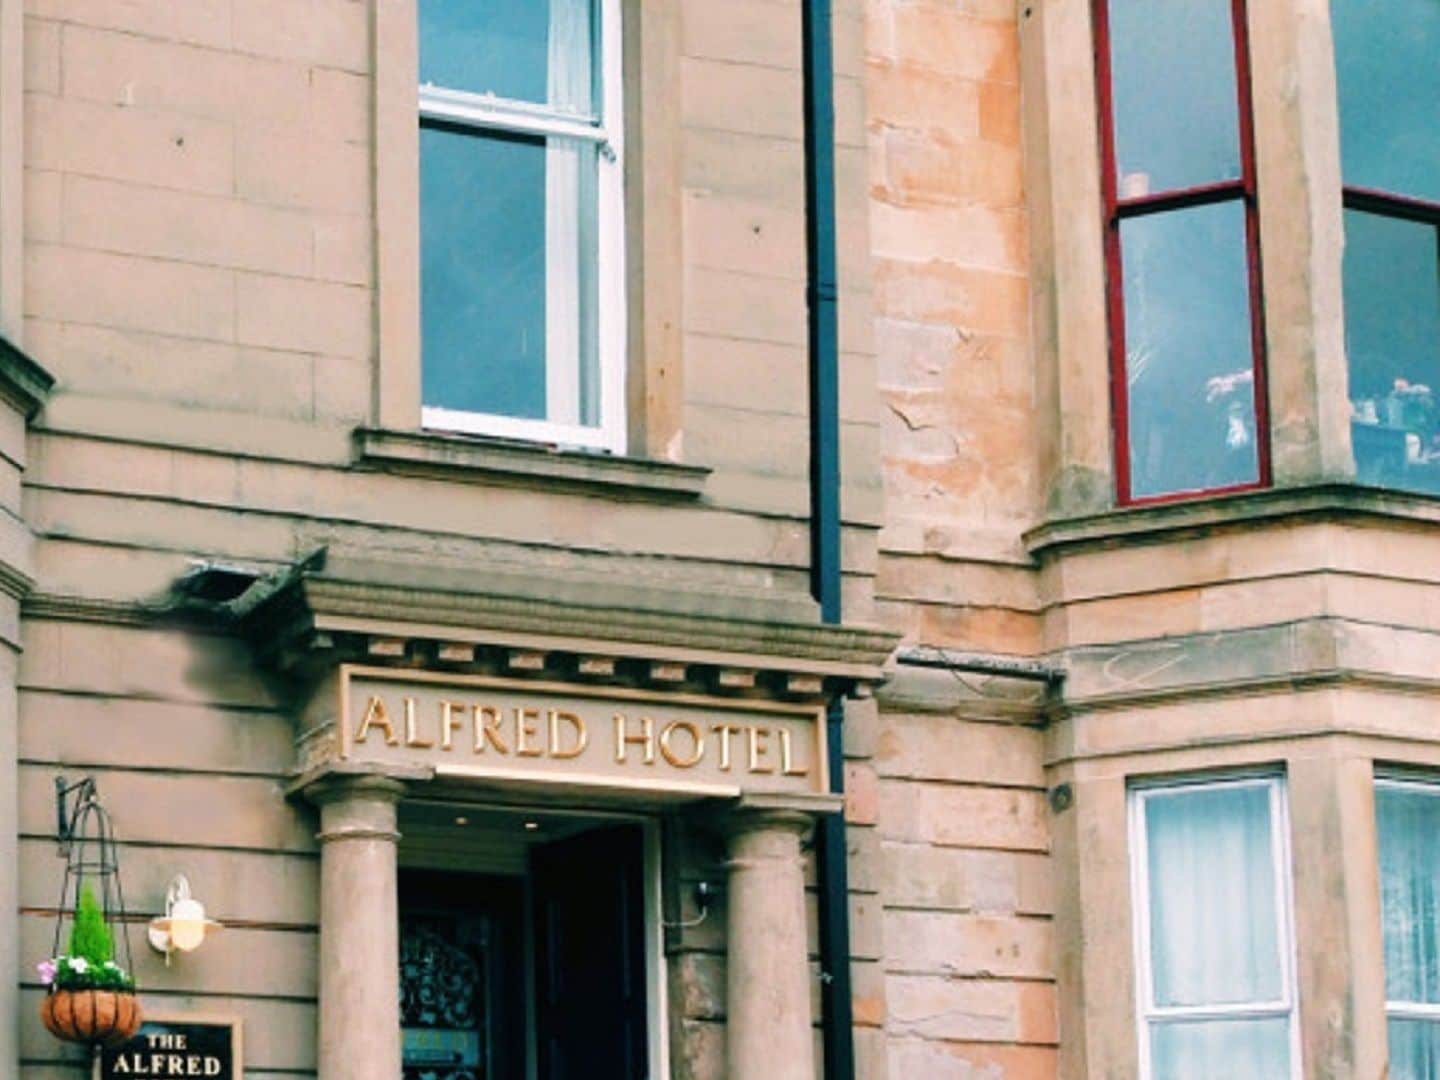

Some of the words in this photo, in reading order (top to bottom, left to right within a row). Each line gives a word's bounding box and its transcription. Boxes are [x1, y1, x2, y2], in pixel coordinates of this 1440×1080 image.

[355, 696, 588, 759] ALFRED
[613, 712, 809, 777] HOTEL
[145, 1033, 188, 1050] THE
[112, 1053, 222, 1077] ALFRED
